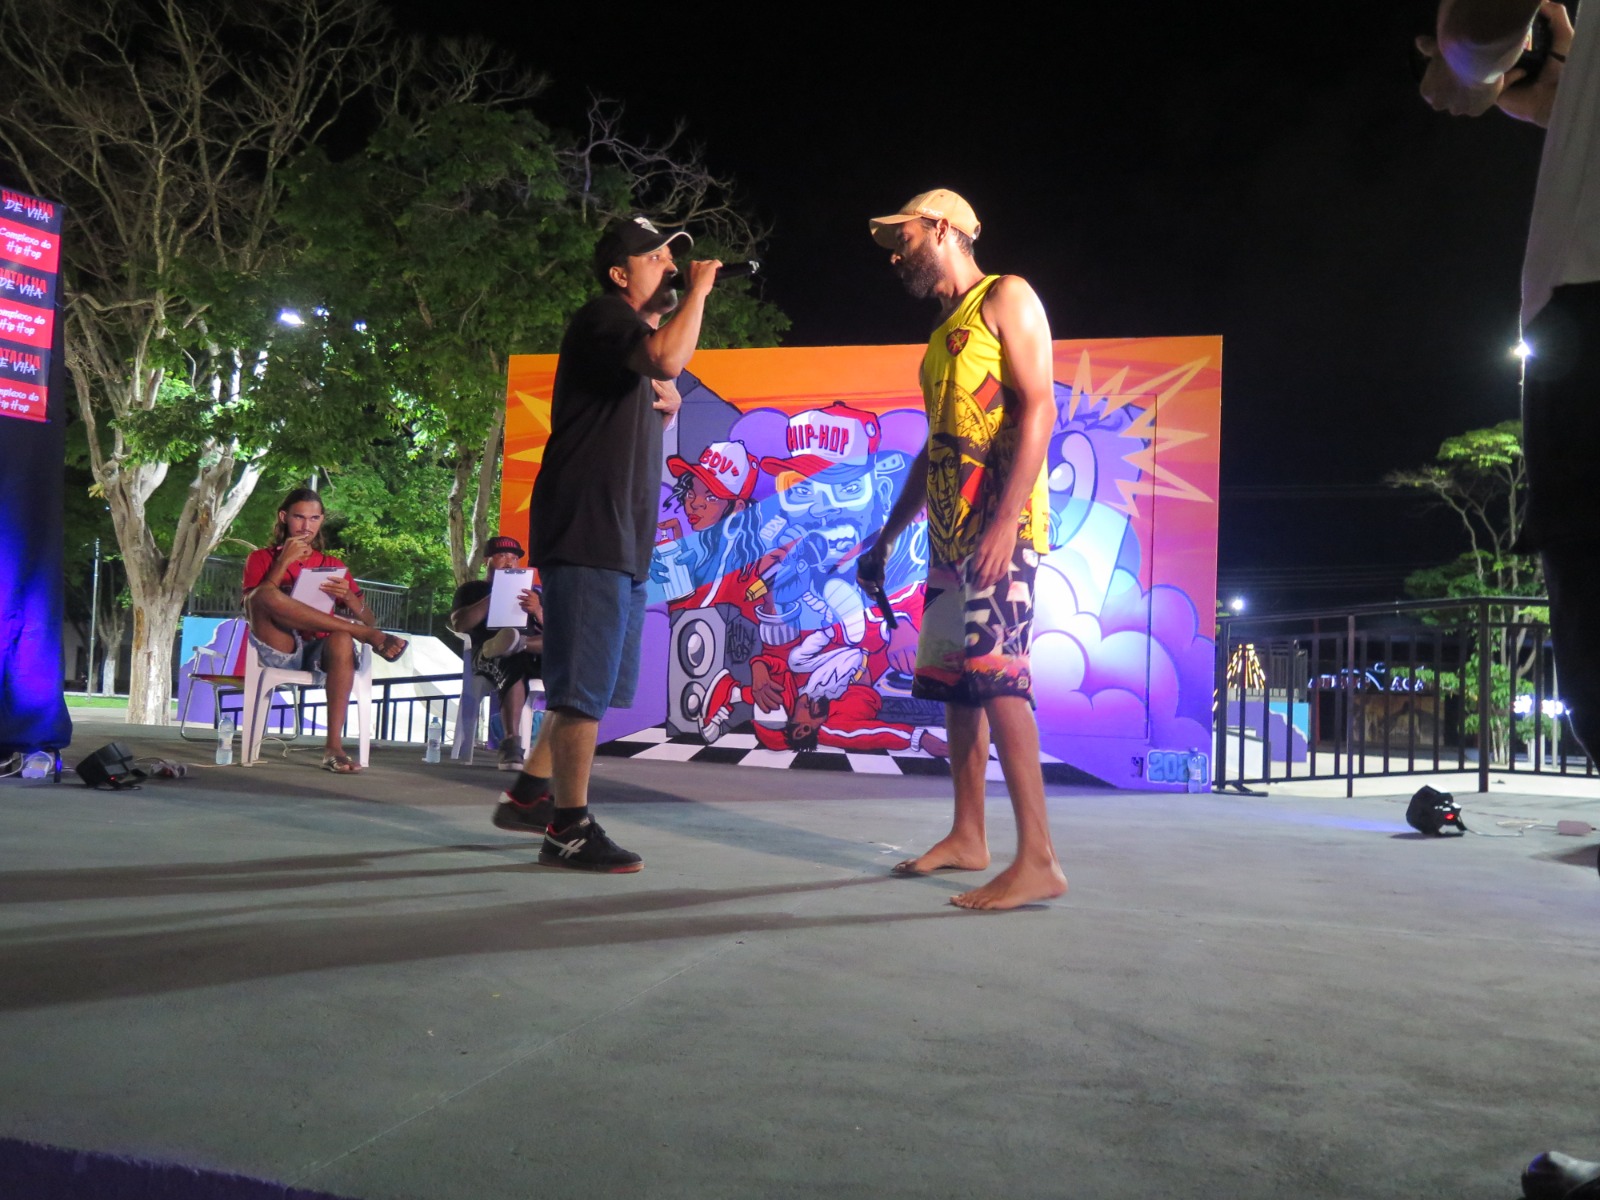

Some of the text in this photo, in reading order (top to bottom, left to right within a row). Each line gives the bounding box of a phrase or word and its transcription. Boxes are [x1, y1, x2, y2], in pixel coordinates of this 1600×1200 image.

[4, 199, 23, 213] DE
[0, 227, 52, 250] Complexo do
[6, 240, 42, 260] Hip Hop
[34, 315, 46, 325] do
[17, 321, 35, 337] Hop
[28, 391, 39, 402] do
[10, 399, 30, 414] Hop
[787, 423, 849, 455] HIP-HOP
